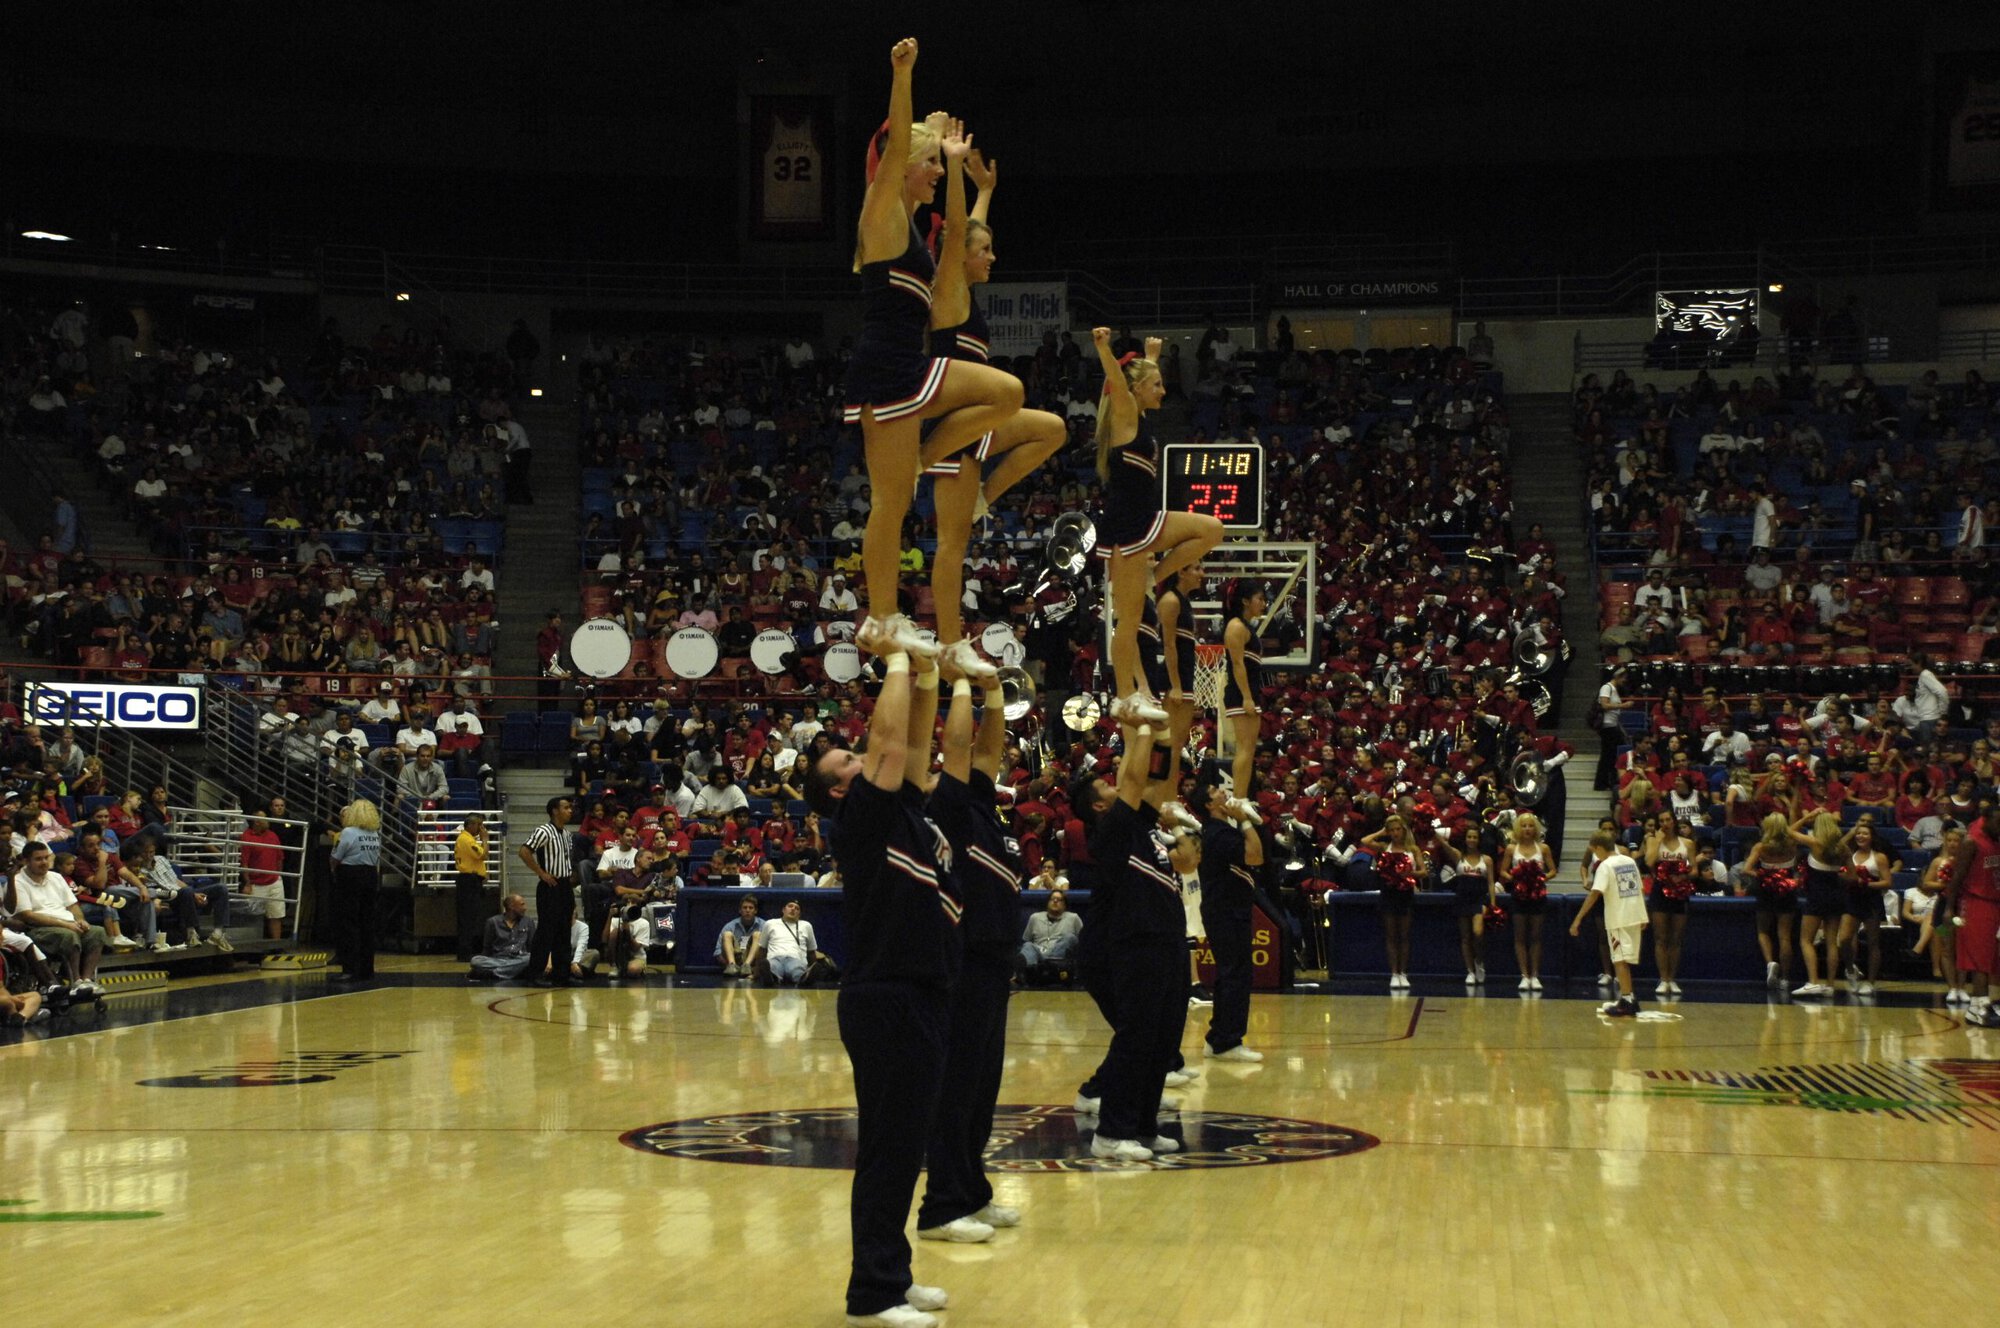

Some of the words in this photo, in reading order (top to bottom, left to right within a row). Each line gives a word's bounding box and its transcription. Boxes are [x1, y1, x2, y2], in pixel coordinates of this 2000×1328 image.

[774, 156, 811, 181] 32
[1284, 284, 1322, 297] HALL
[1327, 284, 1345, 296] OF
[1350, 281, 1439, 296] CHAMPIONS
[982, 294, 1013, 320] Jim
[1020, 293, 1060, 320] Click
[1184, 452, 1251, 475] 11:48
[1187, 484, 1239, 520] 22
[251, 567, 264, 579] 19
[326, 679, 340, 692] 19
[29, 689, 196, 723] GEICO
[1195, 948, 1270, 967] FAO
